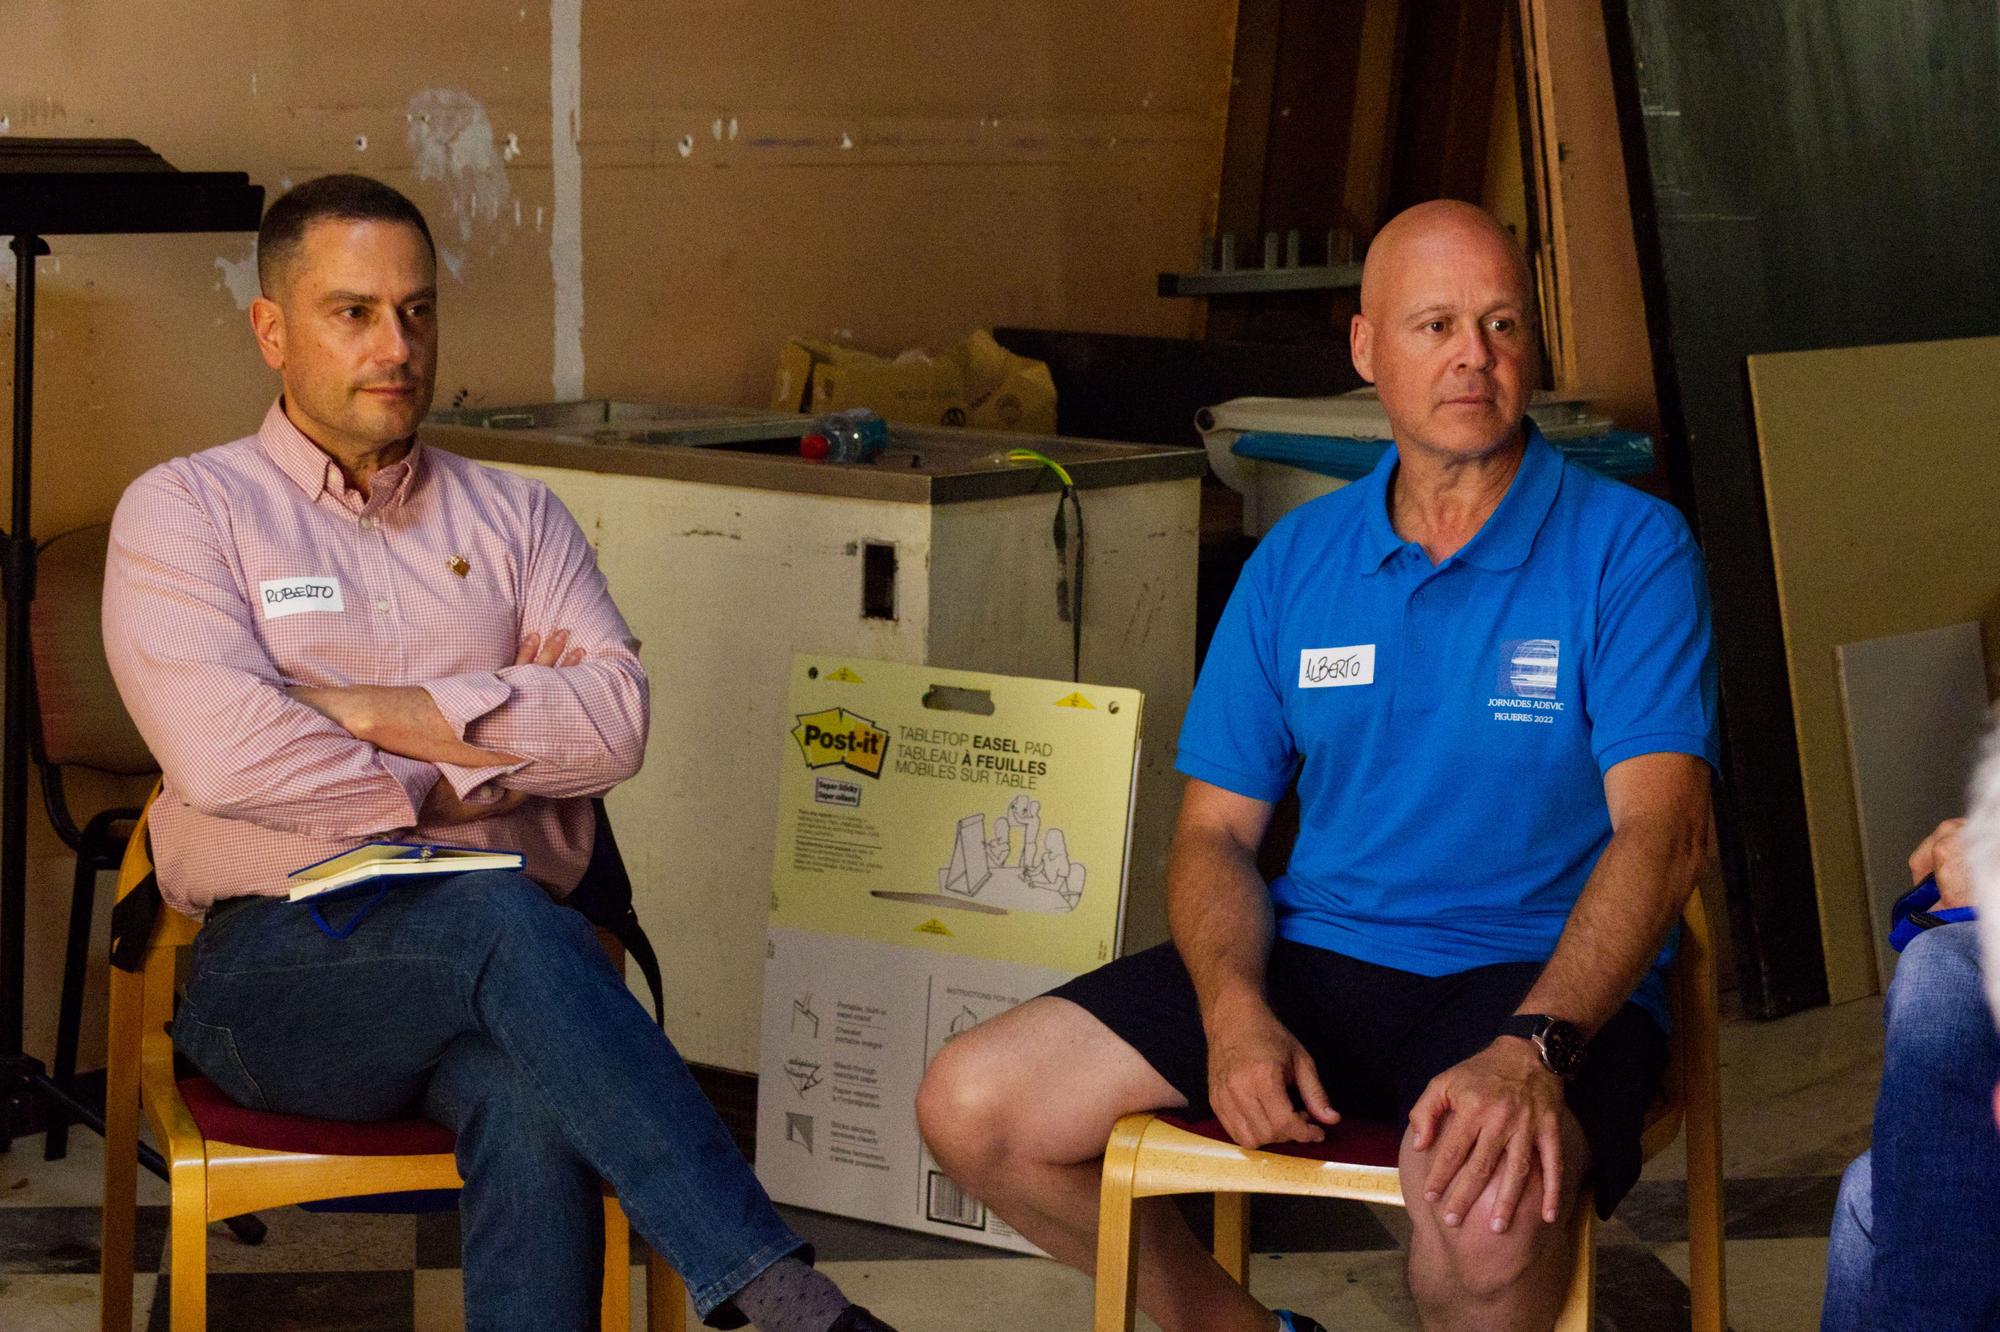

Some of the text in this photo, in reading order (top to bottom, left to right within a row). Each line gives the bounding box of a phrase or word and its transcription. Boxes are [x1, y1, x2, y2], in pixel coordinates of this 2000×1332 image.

[265, 584, 334, 604] ROBERTO
[1487, 698, 1565, 711] JORNADES ADEVIC
[1494, 712, 1554, 724] FIGUERES 2022
[804, 725, 879, 755] Post-it
[898, 726, 1053, 757] TABLETOP EASEL PAD
[897, 744, 1047, 775] TABLEAU À FEUILLES
[895, 760, 1038, 790] MOBILES SUR TABLE
